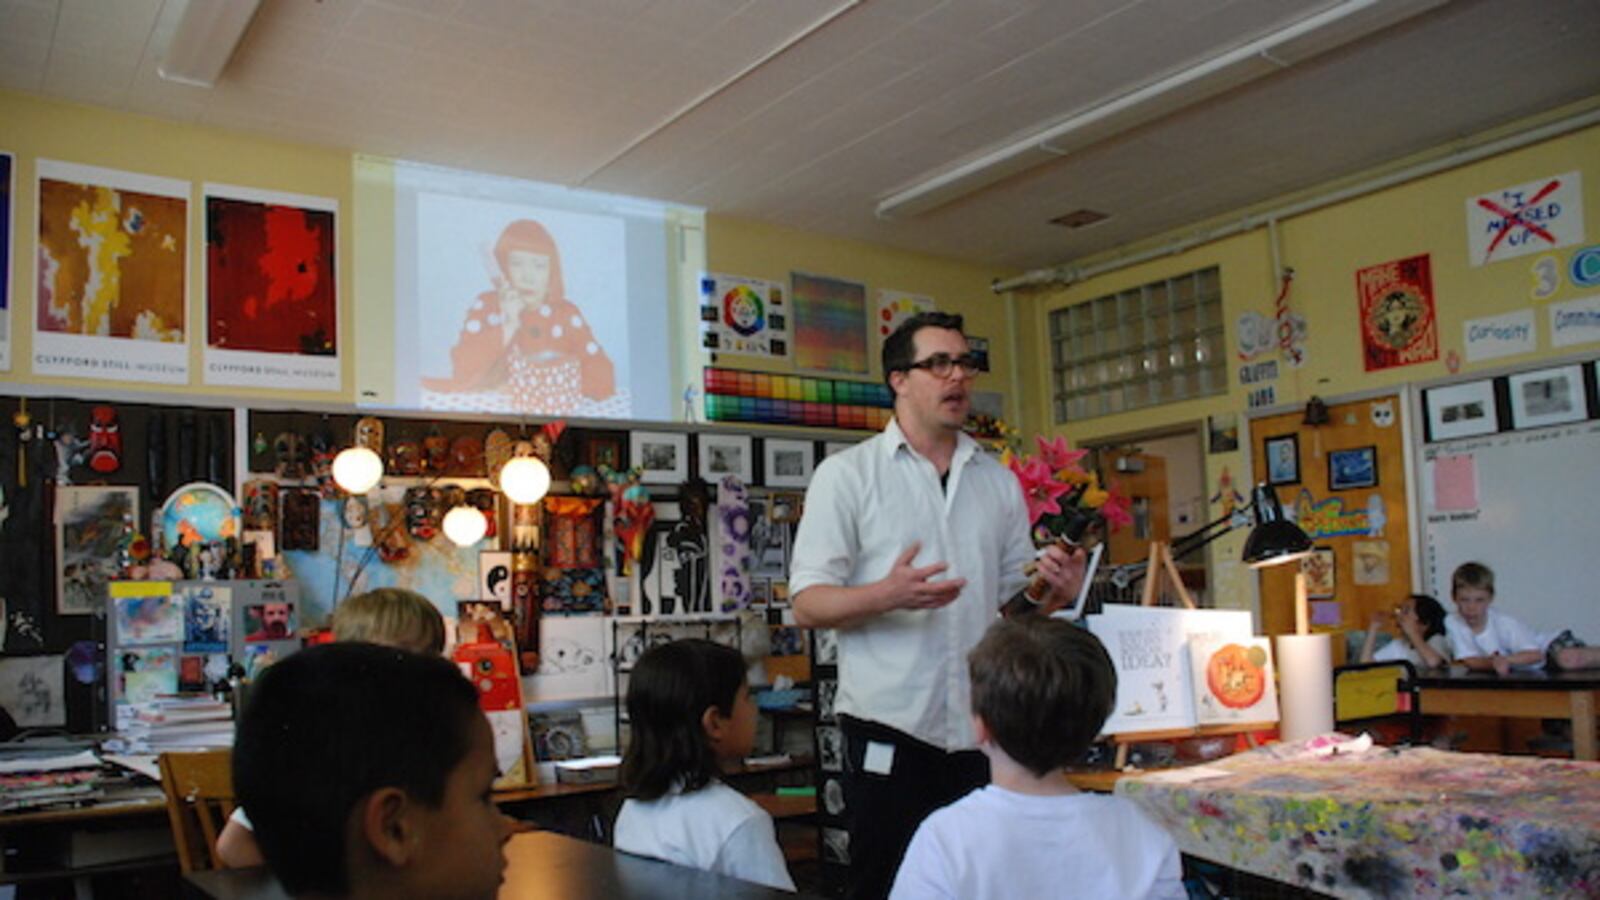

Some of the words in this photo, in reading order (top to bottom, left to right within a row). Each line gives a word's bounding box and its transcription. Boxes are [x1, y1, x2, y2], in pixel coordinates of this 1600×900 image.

[1468, 322, 1530, 343] Curiosity
[102, 358, 130, 370] STILL
[136, 362, 186, 374] MUSEUM
